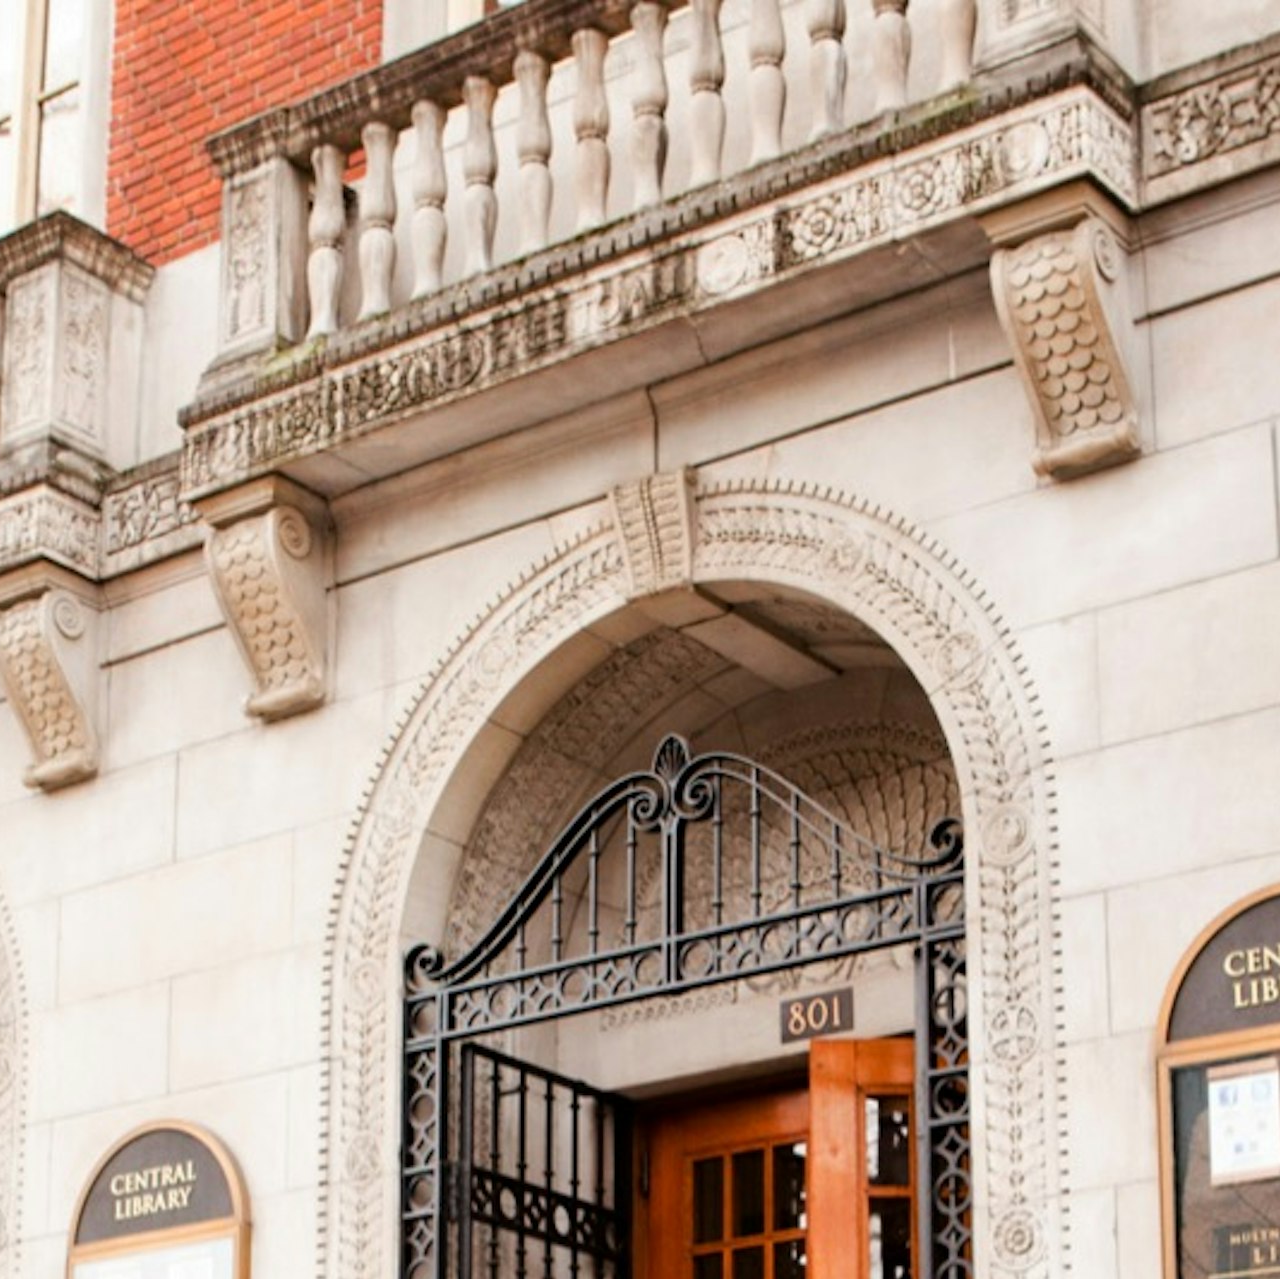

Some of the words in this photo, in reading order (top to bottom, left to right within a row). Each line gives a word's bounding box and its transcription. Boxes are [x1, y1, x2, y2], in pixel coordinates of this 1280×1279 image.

[788, 996, 840, 1036] 801
[110, 1160, 197, 1197] CENTRAL
[114, 1186, 192, 1220] LIBRARY
